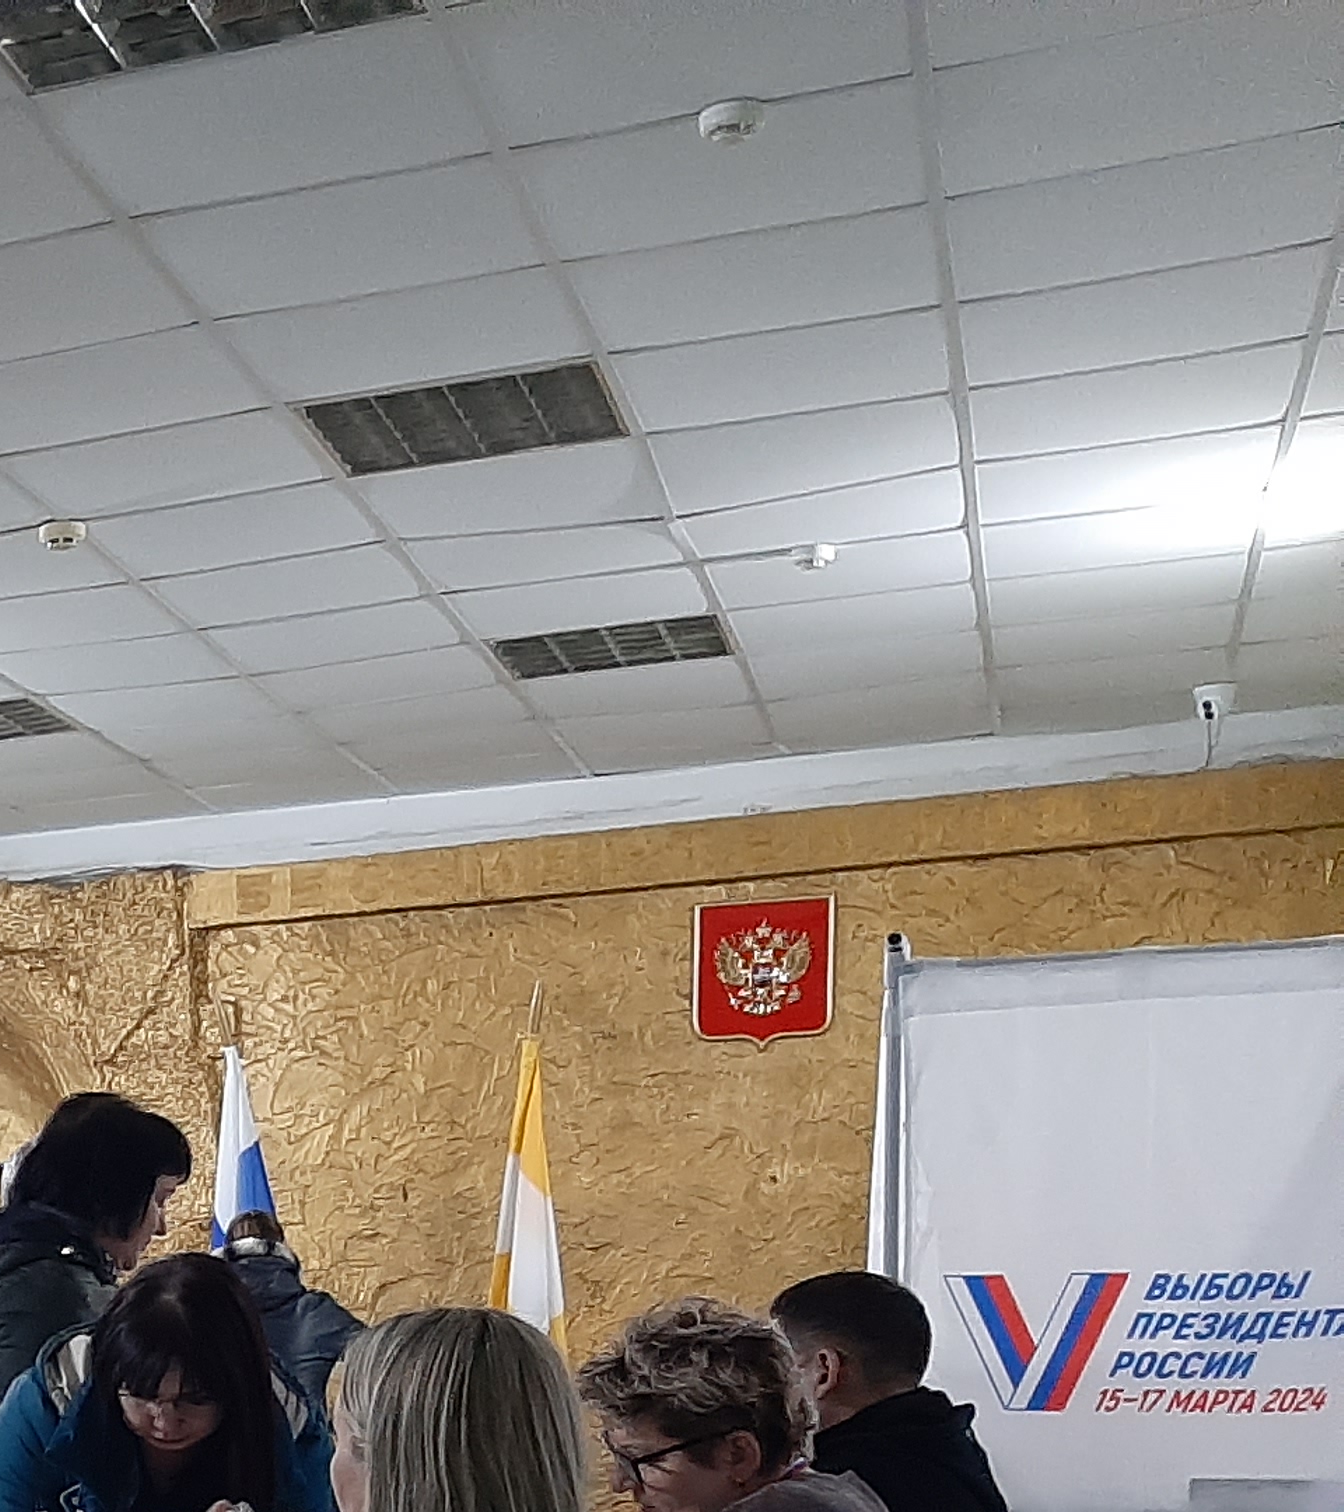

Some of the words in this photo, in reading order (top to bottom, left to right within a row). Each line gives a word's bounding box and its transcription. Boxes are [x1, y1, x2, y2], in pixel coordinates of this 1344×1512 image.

[1144, 1270, 1312, 1300] ВЫБОРЫ
[1109, 1351, 1258, 1379] РОССИИ
[1166, 1388, 1257, 1413] МАРТА
[1260, 1386, 1328, 1413] 2024
